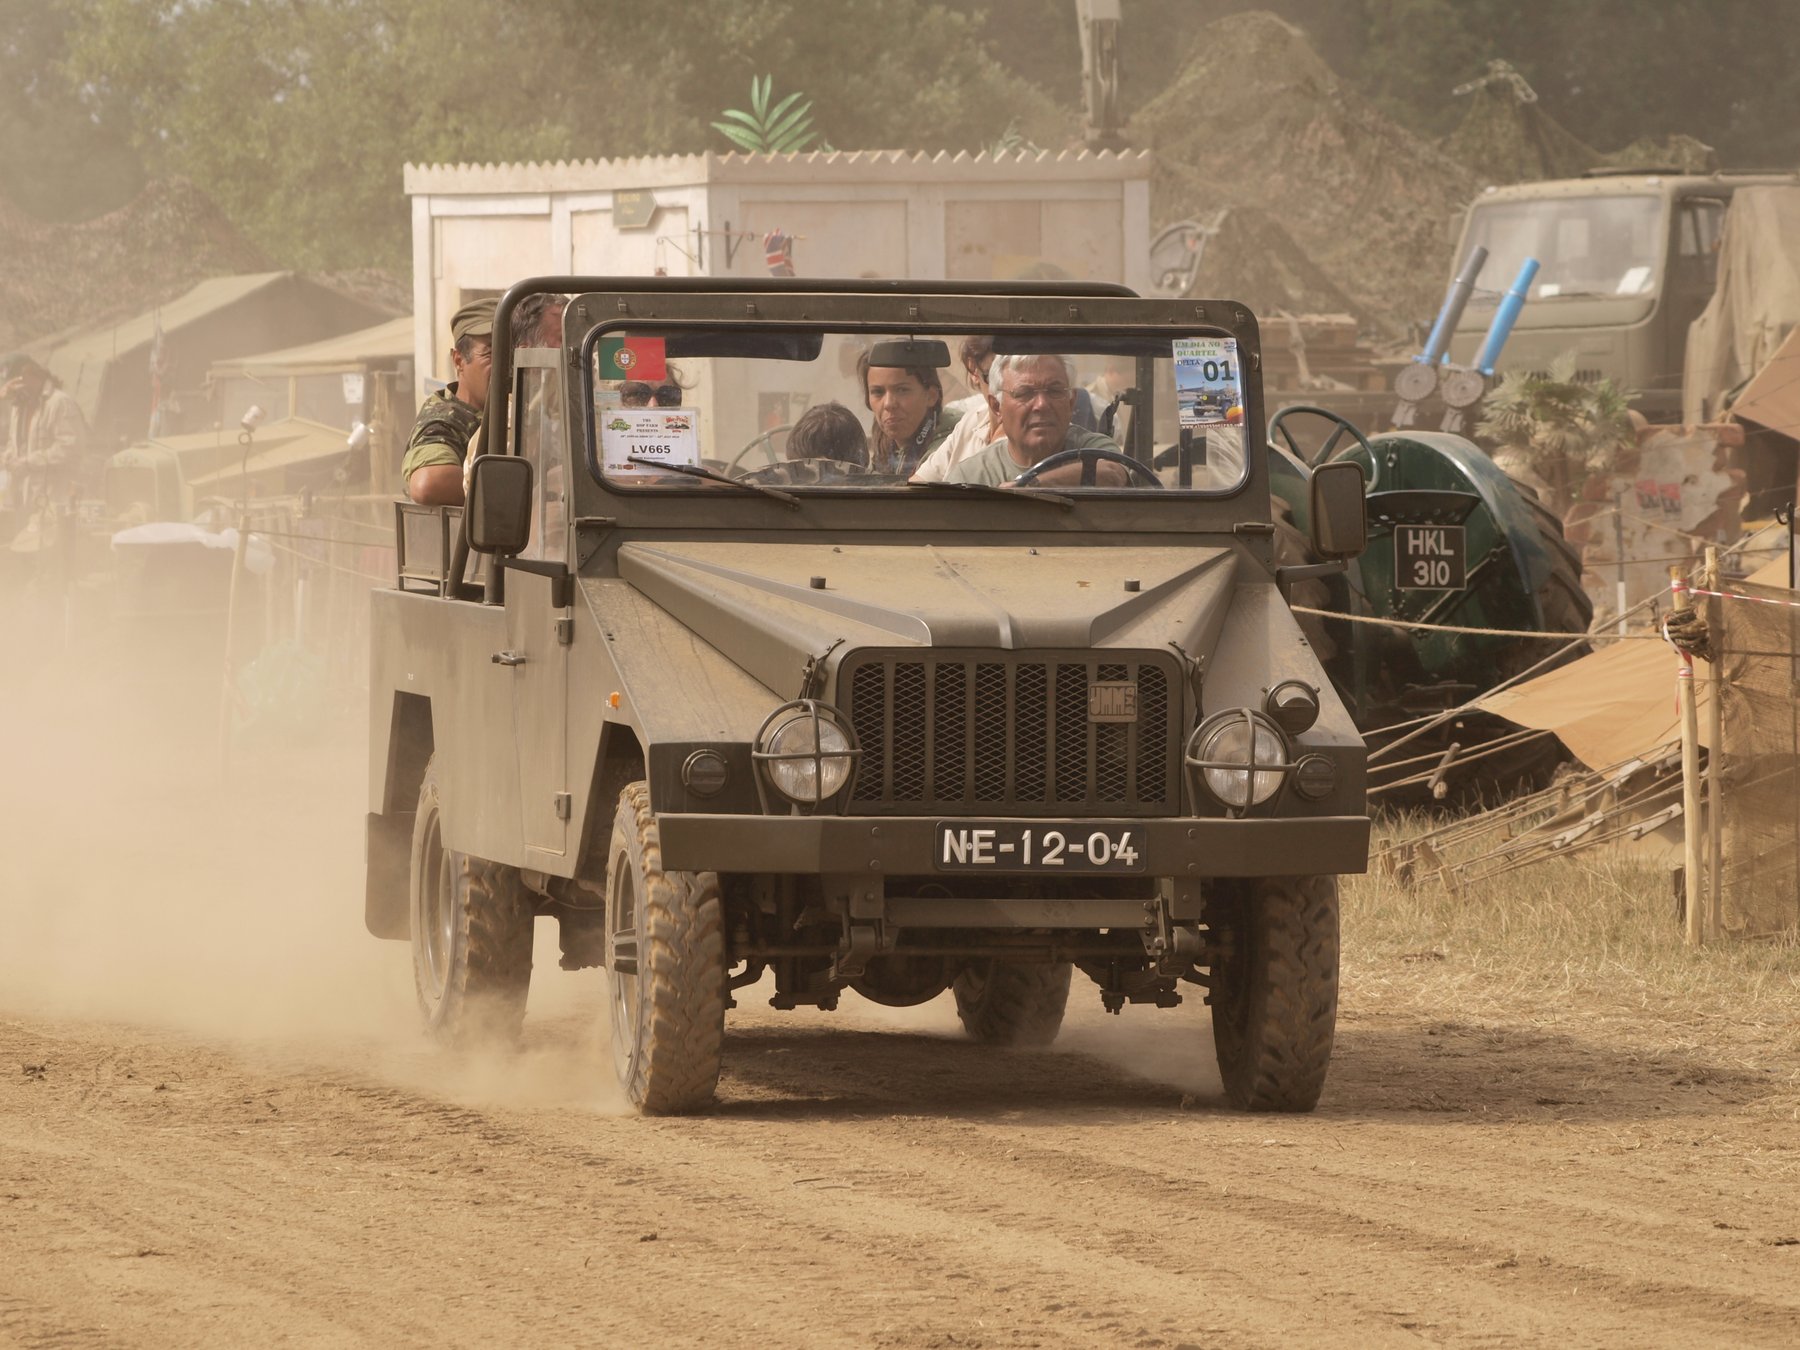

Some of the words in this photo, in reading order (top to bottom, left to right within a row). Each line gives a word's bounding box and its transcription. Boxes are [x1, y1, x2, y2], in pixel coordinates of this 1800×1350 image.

[1177, 349, 1218, 357] QUARTEL
[1203, 360, 1235, 382] 01
[631, 444, 671, 454] LV665
[1407, 529, 1455, 556] HKL
[1413, 560, 1450, 586] 310
[943, 829, 1139, 866] NE-12-04
